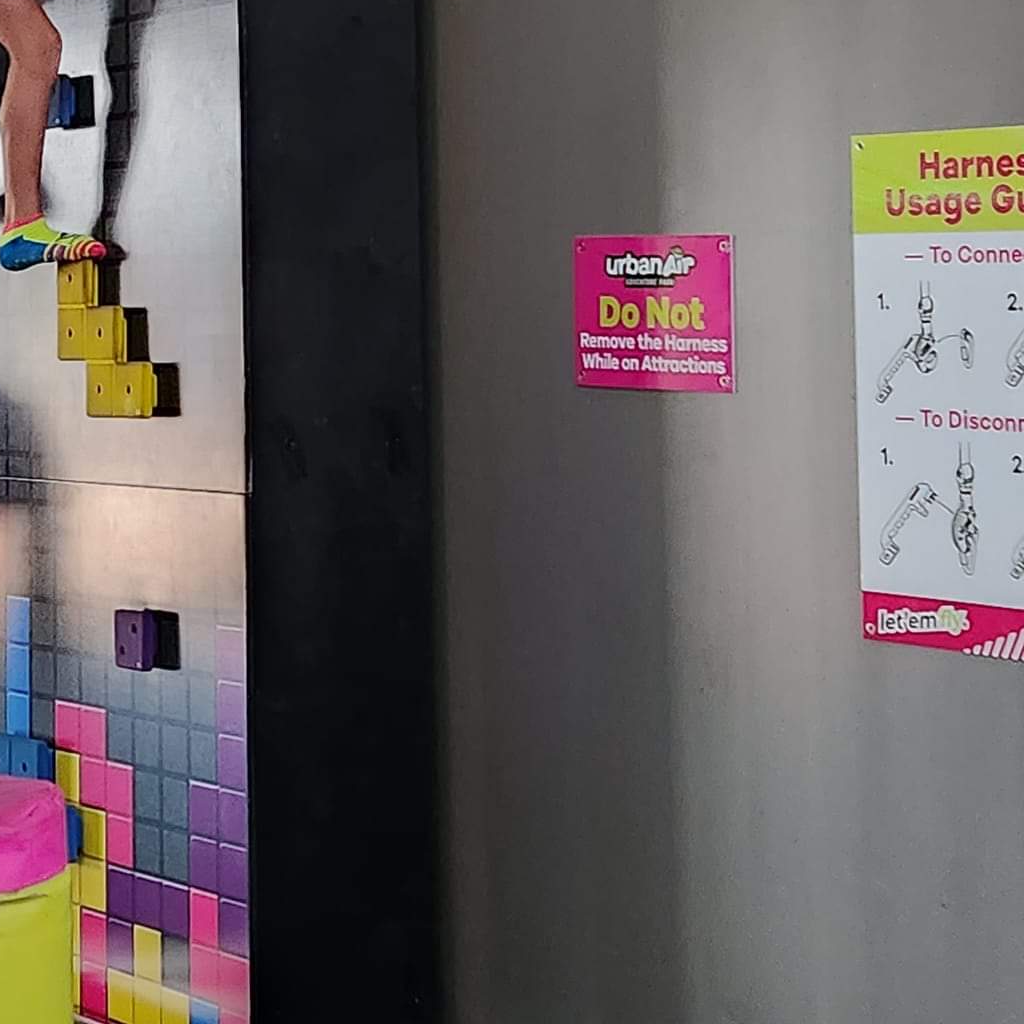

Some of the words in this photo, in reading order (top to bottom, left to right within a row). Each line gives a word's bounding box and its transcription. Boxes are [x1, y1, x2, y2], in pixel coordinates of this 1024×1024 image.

[885, 188, 982, 225] Usage
[929, 245, 952, 264] To
[958, 245, 1024, 264] Conne
[877, 292, 890, 310] 1.
[599, 295, 640, 328] Do
[646, 295, 705, 331] Not
[579, 332, 636, 350] Remove
[637, 332, 663, 351] the
[665, 334, 728, 353] Harness
[581, 352, 619, 370] While
[621, 358, 639, 371] on
[641, 355, 726, 375] Attractions
[920, 409, 943, 428] To
[881, 448, 893, 466] 1.
